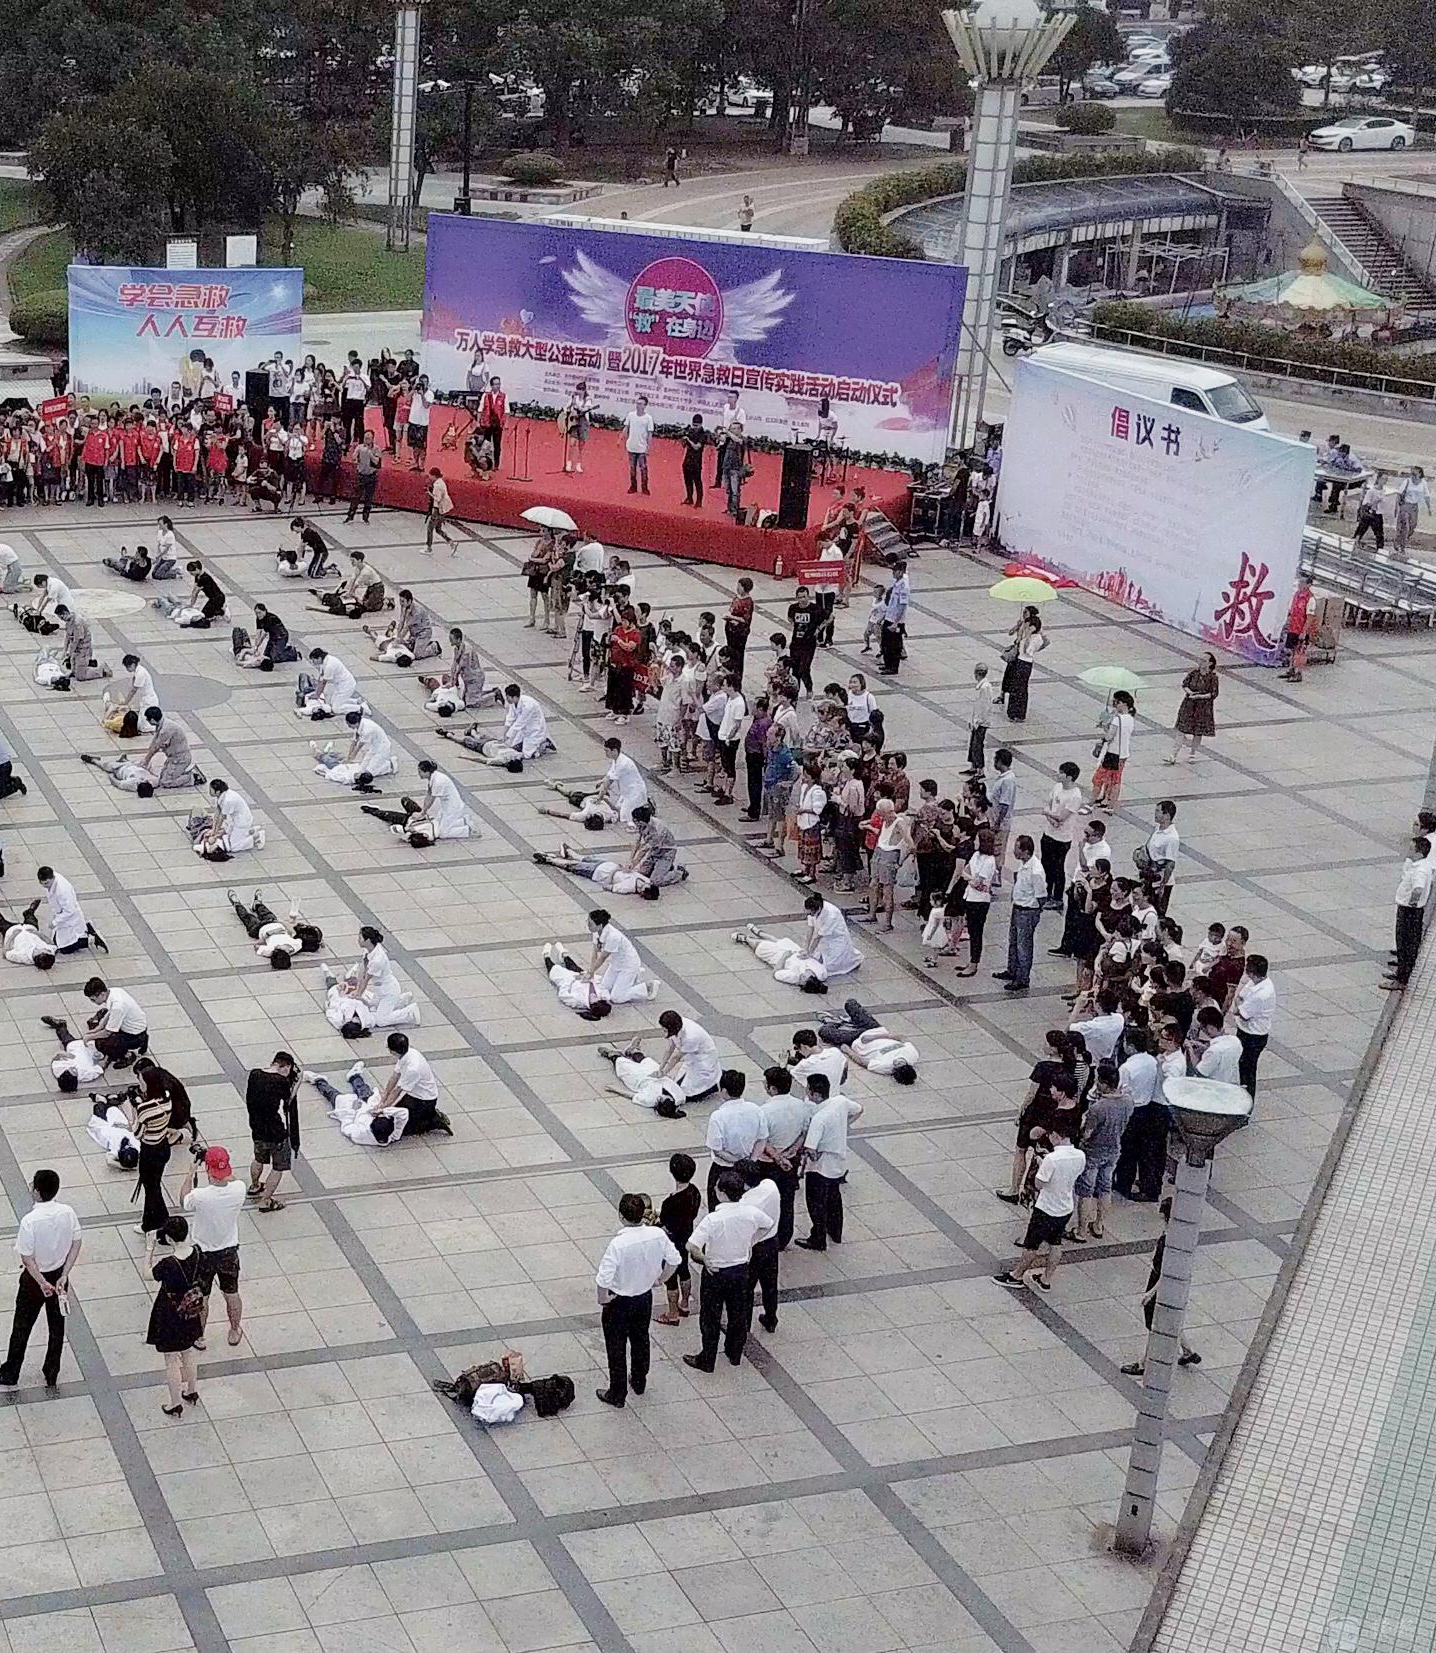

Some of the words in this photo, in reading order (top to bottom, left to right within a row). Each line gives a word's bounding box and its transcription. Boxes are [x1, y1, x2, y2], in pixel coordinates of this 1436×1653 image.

[118, 284, 231, 309] 学会急救
[136, 313, 248, 339] 人人互救
[1111, 406, 1182, 456] 倡议书
[1214, 551, 1278, 650] 救
